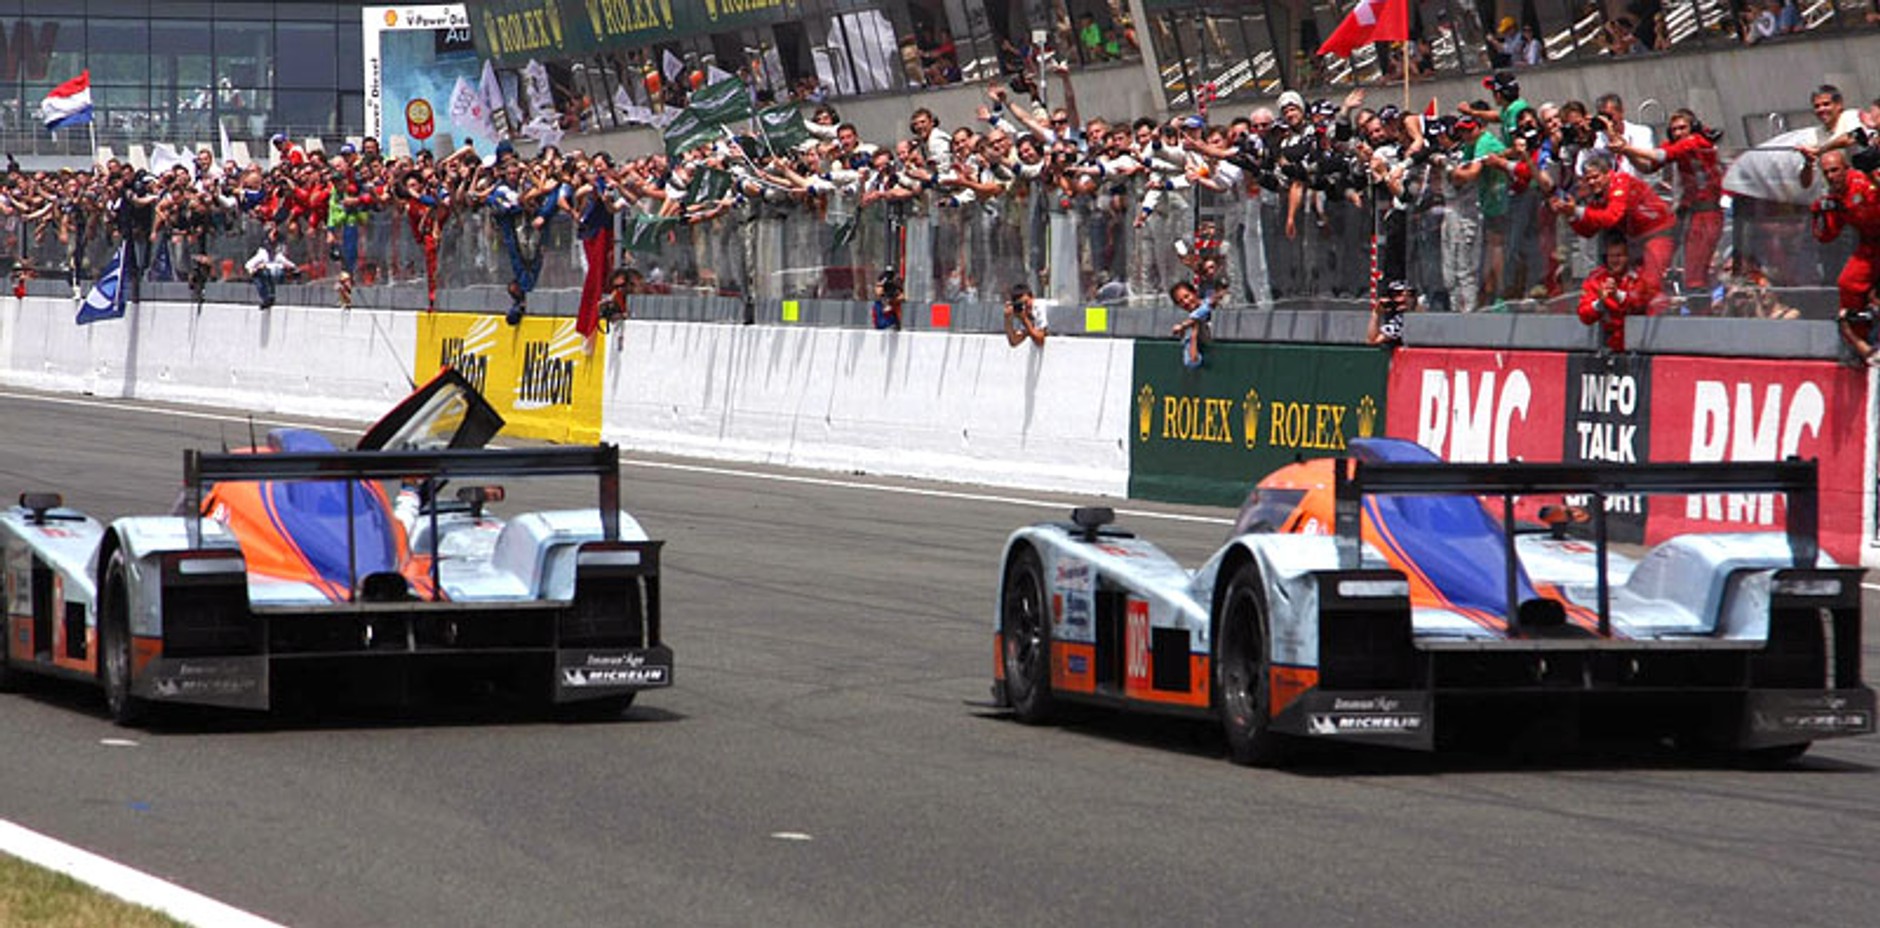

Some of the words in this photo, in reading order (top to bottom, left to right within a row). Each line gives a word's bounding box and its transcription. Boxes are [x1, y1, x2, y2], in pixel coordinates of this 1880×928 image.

[498, 9, 551, 52] ROLEX
[519, 341, 573, 405] Nikon
[1581, 374, 1637, 415] INFO
[1162, 396, 1233, 443] ROLEX
[1269, 401, 1346, 450] ROLEX
[1577, 421, 1637, 463] TALK
[589, 670, 662, 680] MICHELIN
[1339, 716, 1421, 728] MICHELIN
